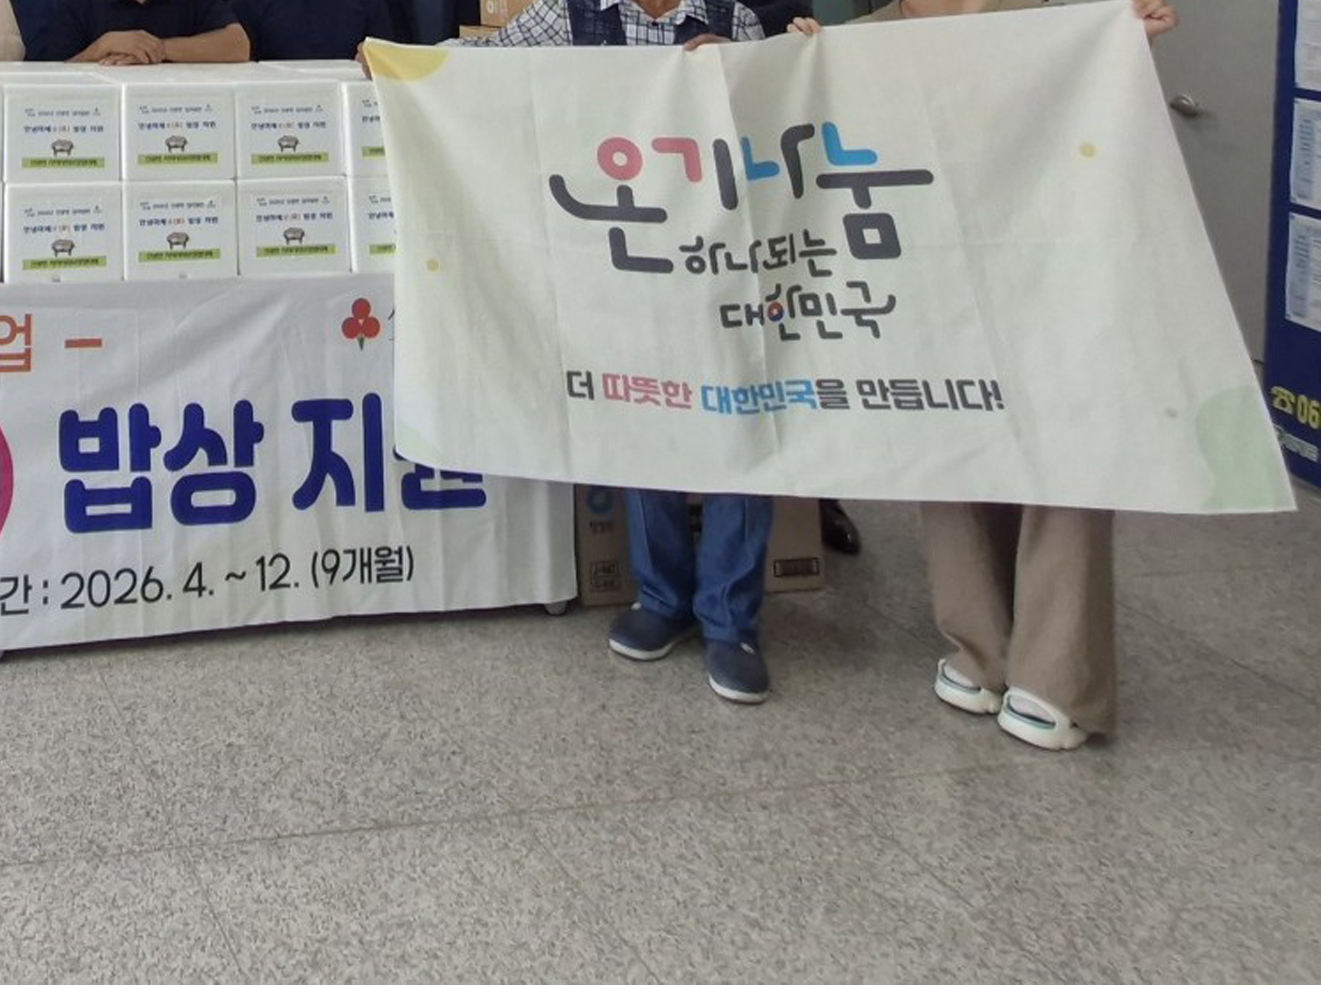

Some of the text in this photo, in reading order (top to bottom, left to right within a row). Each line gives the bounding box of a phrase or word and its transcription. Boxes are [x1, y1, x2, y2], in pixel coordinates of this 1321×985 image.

[549, 121, 934, 274] 온기나눔
[679, 229, 837, 277] 하나되는
[719, 281, 897, 341] 대한민국
[566, 370, 1005, 416] 더 따뜻한 대한민국을 만듭니다!
[57, 399, 266, 534] 밥상
[59, 566, 173, 610] 2026.
[310, 545, 415, 589] (9개월)
